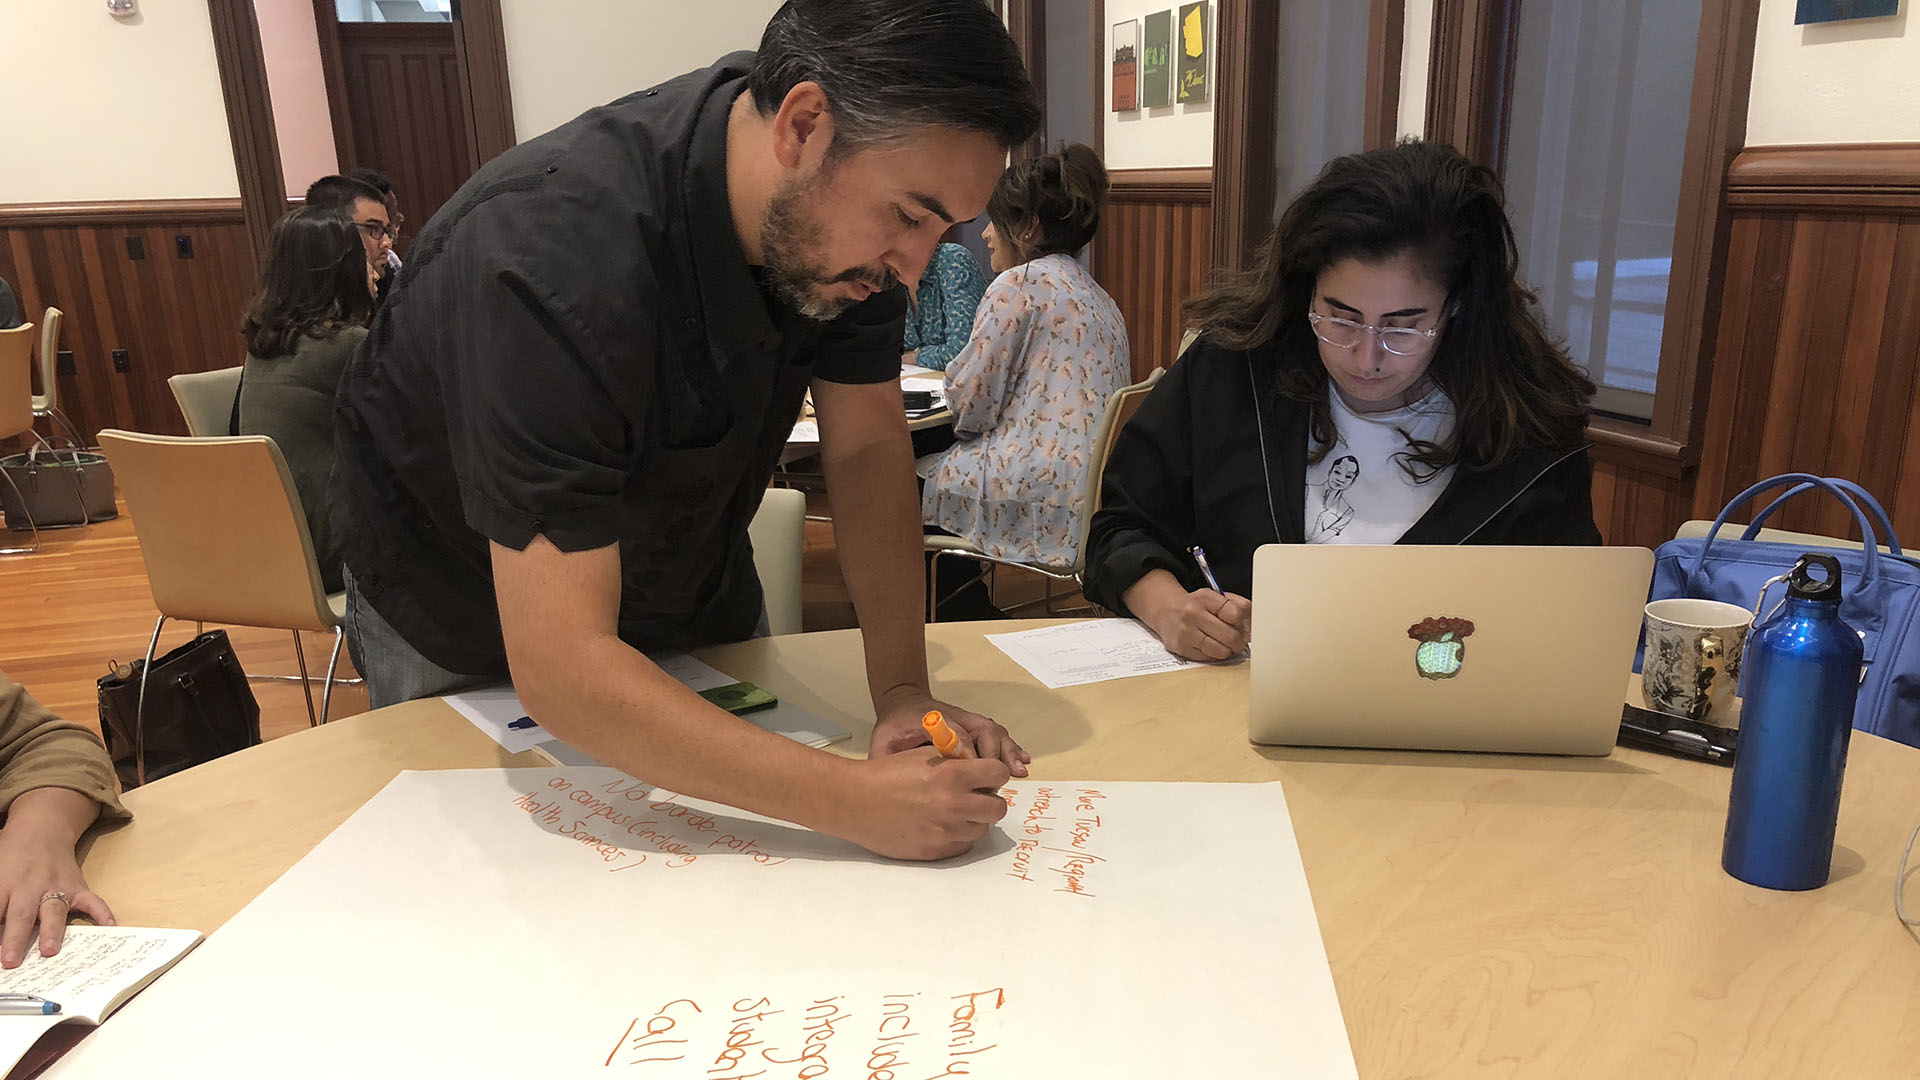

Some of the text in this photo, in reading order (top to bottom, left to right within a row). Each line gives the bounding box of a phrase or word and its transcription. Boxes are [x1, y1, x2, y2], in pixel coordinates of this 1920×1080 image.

[511, 791, 561, 825] Health
[548, 776, 572, 792] on
[569, 789, 631, 825] campus
[602, 779, 649, 801] No
[1022, 823, 1055, 835] to
[866, 992, 921, 1080] include
[924, 987, 1005, 1080] Family
